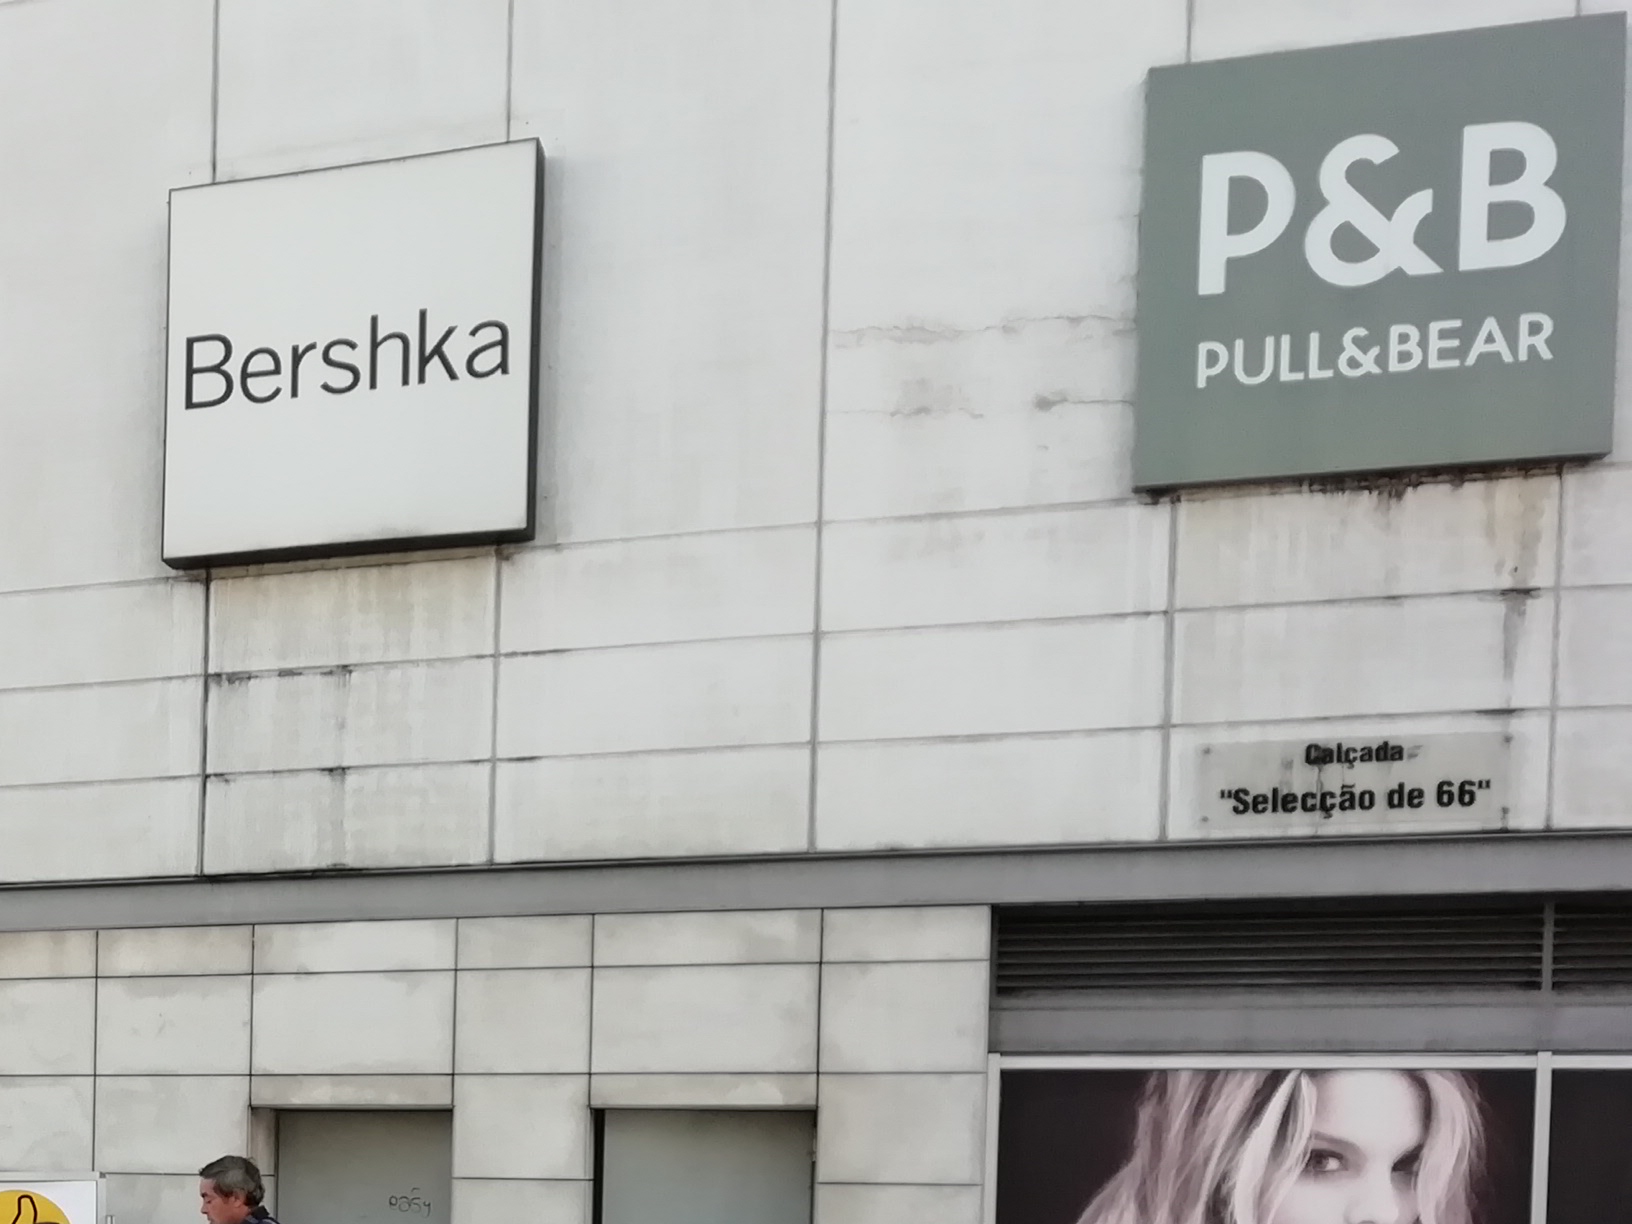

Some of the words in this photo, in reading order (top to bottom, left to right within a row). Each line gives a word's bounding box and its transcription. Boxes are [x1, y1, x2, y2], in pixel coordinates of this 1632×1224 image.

[1197, 120, 1567, 296] P&B
[184, 307, 511, 411] Bershka
[1196, 312, 1555, 389] PULL&BEAR
[1304, 740, 1405, 770] Calçada
[1386, 782, 1426, 810] de
